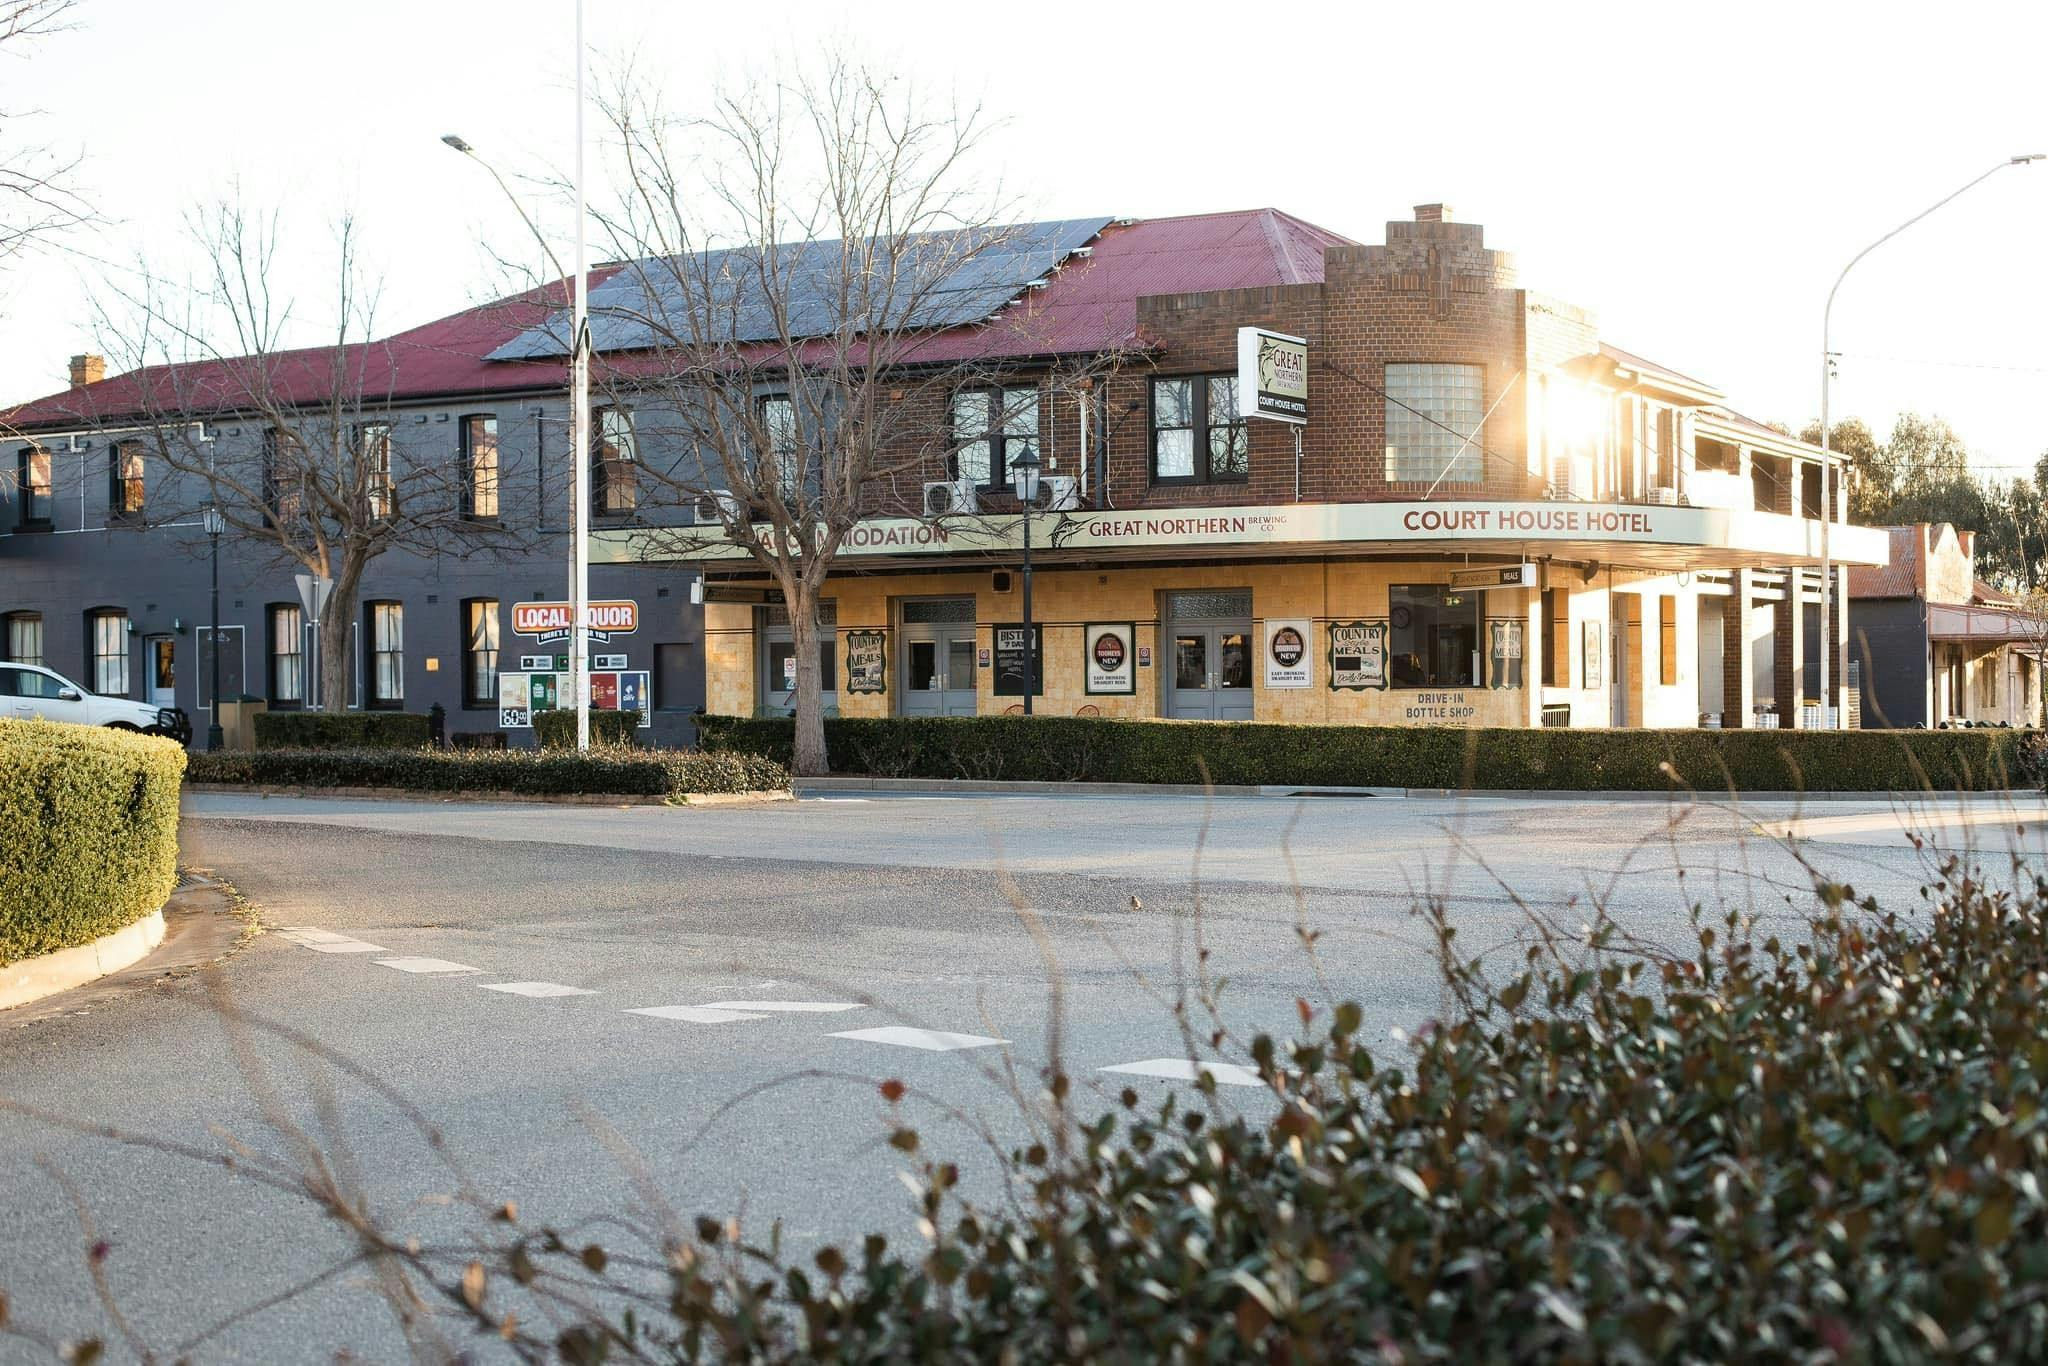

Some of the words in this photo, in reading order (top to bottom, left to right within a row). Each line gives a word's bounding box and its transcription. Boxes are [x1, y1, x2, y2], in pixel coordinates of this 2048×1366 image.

[1273, 349, 1303, 371] GREAT
[1275, 368, 1303, 383] NORTHERN
[1258, 395, 1274, 406] COURT
[1275, 399, 1290, 410] HOUSE
[1290, 402, 1306, 412] HOTEL
[1089, 520, 1143, 537] GREAT
[1147, 517, 1245, 535] NORTHERN
[1248, 516, 1287, 524] BREWING
[1403, 510, 1490, 531] COURT
[1499, 510, 1579, 531] HOUSE
[1586, 512, 1653, 533] HOTEL
[1503, 571, 1519, 581] MEALS
[518, 608, 570, 628] LOCAL
[577, 607, 633, 628] QUOR
[1000, 631, 1034, 641] BIST
[1335, 628, 1380, 642] COUNTRY
[852, 635, 881, 650] COUNTRY
[1280, 652, 1296, 660] NEW
[1335, 646, 1380, 655] MEALS
[851, 653, 881, 668] MEALS
[1102, 657, 1118, 665] NEW
[1418, 692, 1464, 703] DRIVE-IN
[1406, 707, 1446, 718] BOTTLE
[1449, 707, 1474, 718] SHOP
